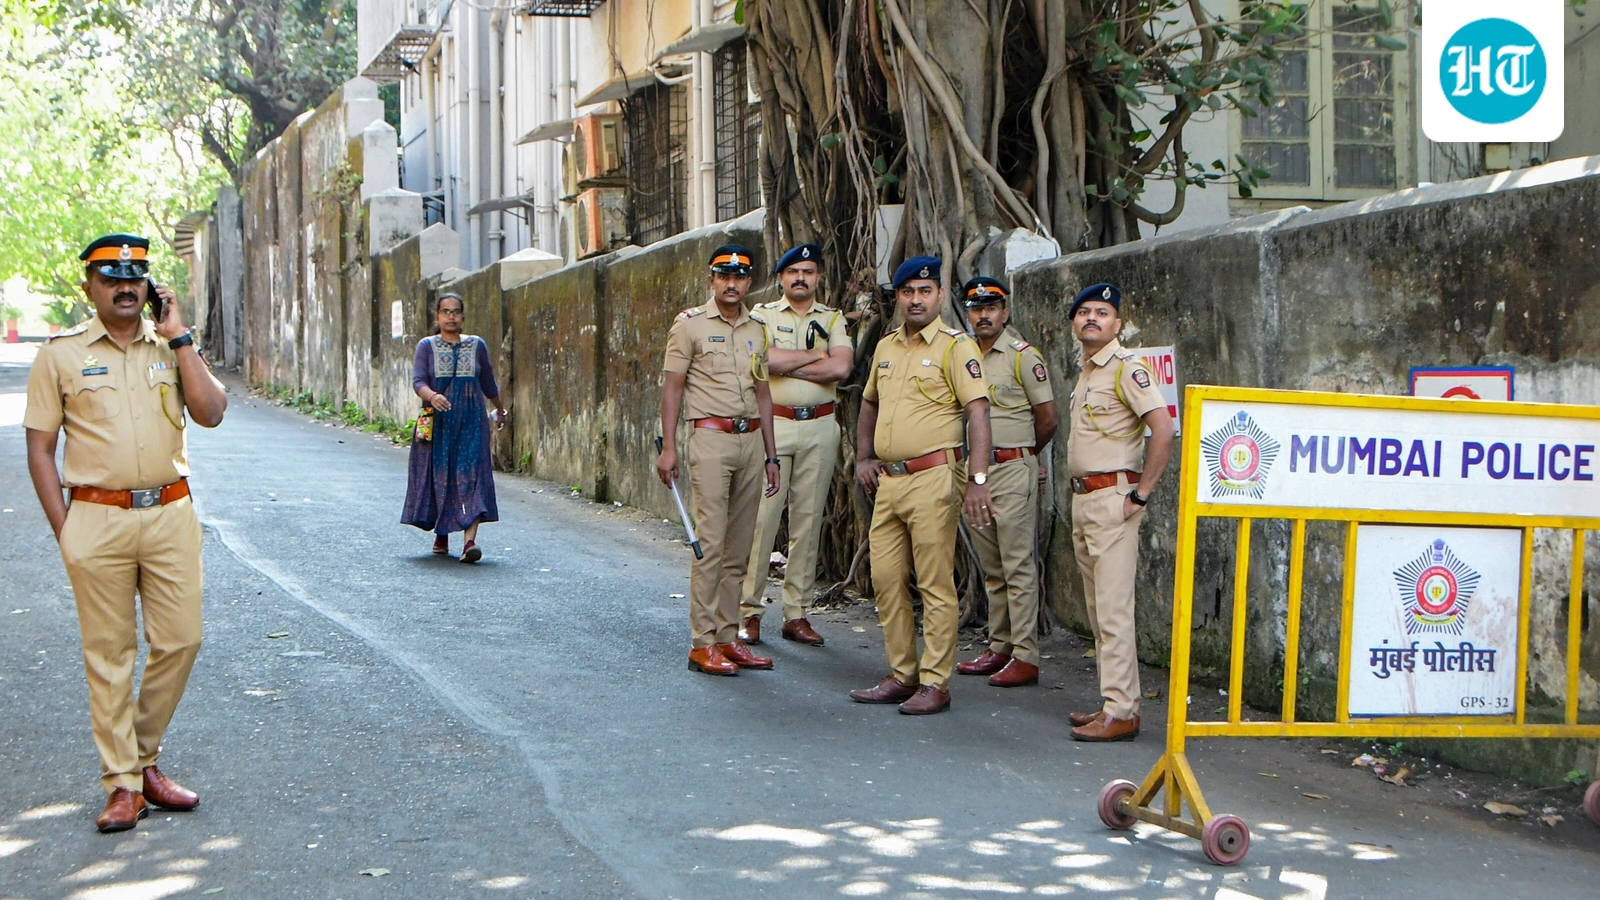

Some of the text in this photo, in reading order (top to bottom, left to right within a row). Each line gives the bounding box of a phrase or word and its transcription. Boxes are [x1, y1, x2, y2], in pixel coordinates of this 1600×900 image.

[1289, 434, 1441, 478] MUMBAI
[1461, 441, 1595, 481] POLICE
[1369, 639, 1497, 679] मुंबई पोलीस
[1460, 696, 1486, 708] GPS
[1494, 697, 1509, 708] 32
